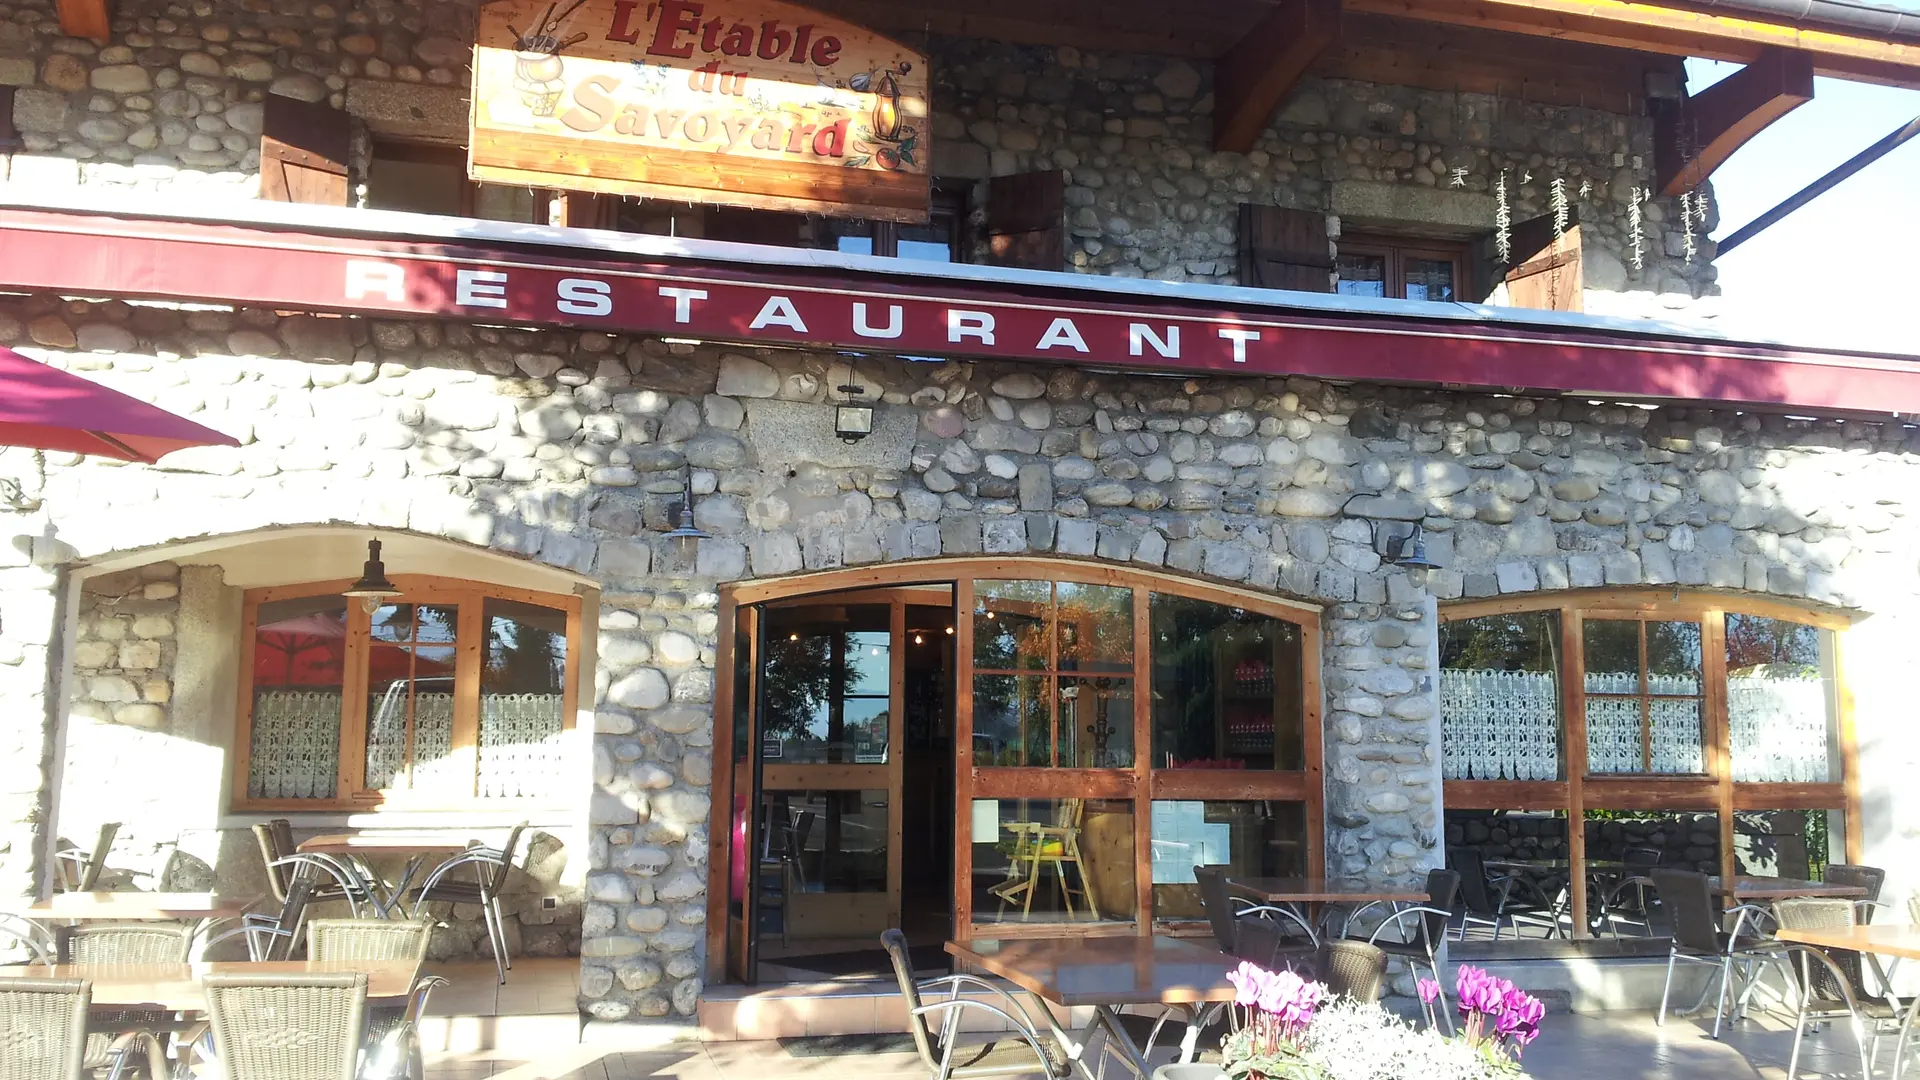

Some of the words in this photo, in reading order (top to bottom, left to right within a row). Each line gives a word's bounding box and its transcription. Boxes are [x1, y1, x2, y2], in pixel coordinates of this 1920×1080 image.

[605, 0, 842, 66] L'Etable
[560, 74, 852, 157] Savoyard
[688, 60, 748, 97] du
[345, 259, 1261, 363] RESTAURANT
